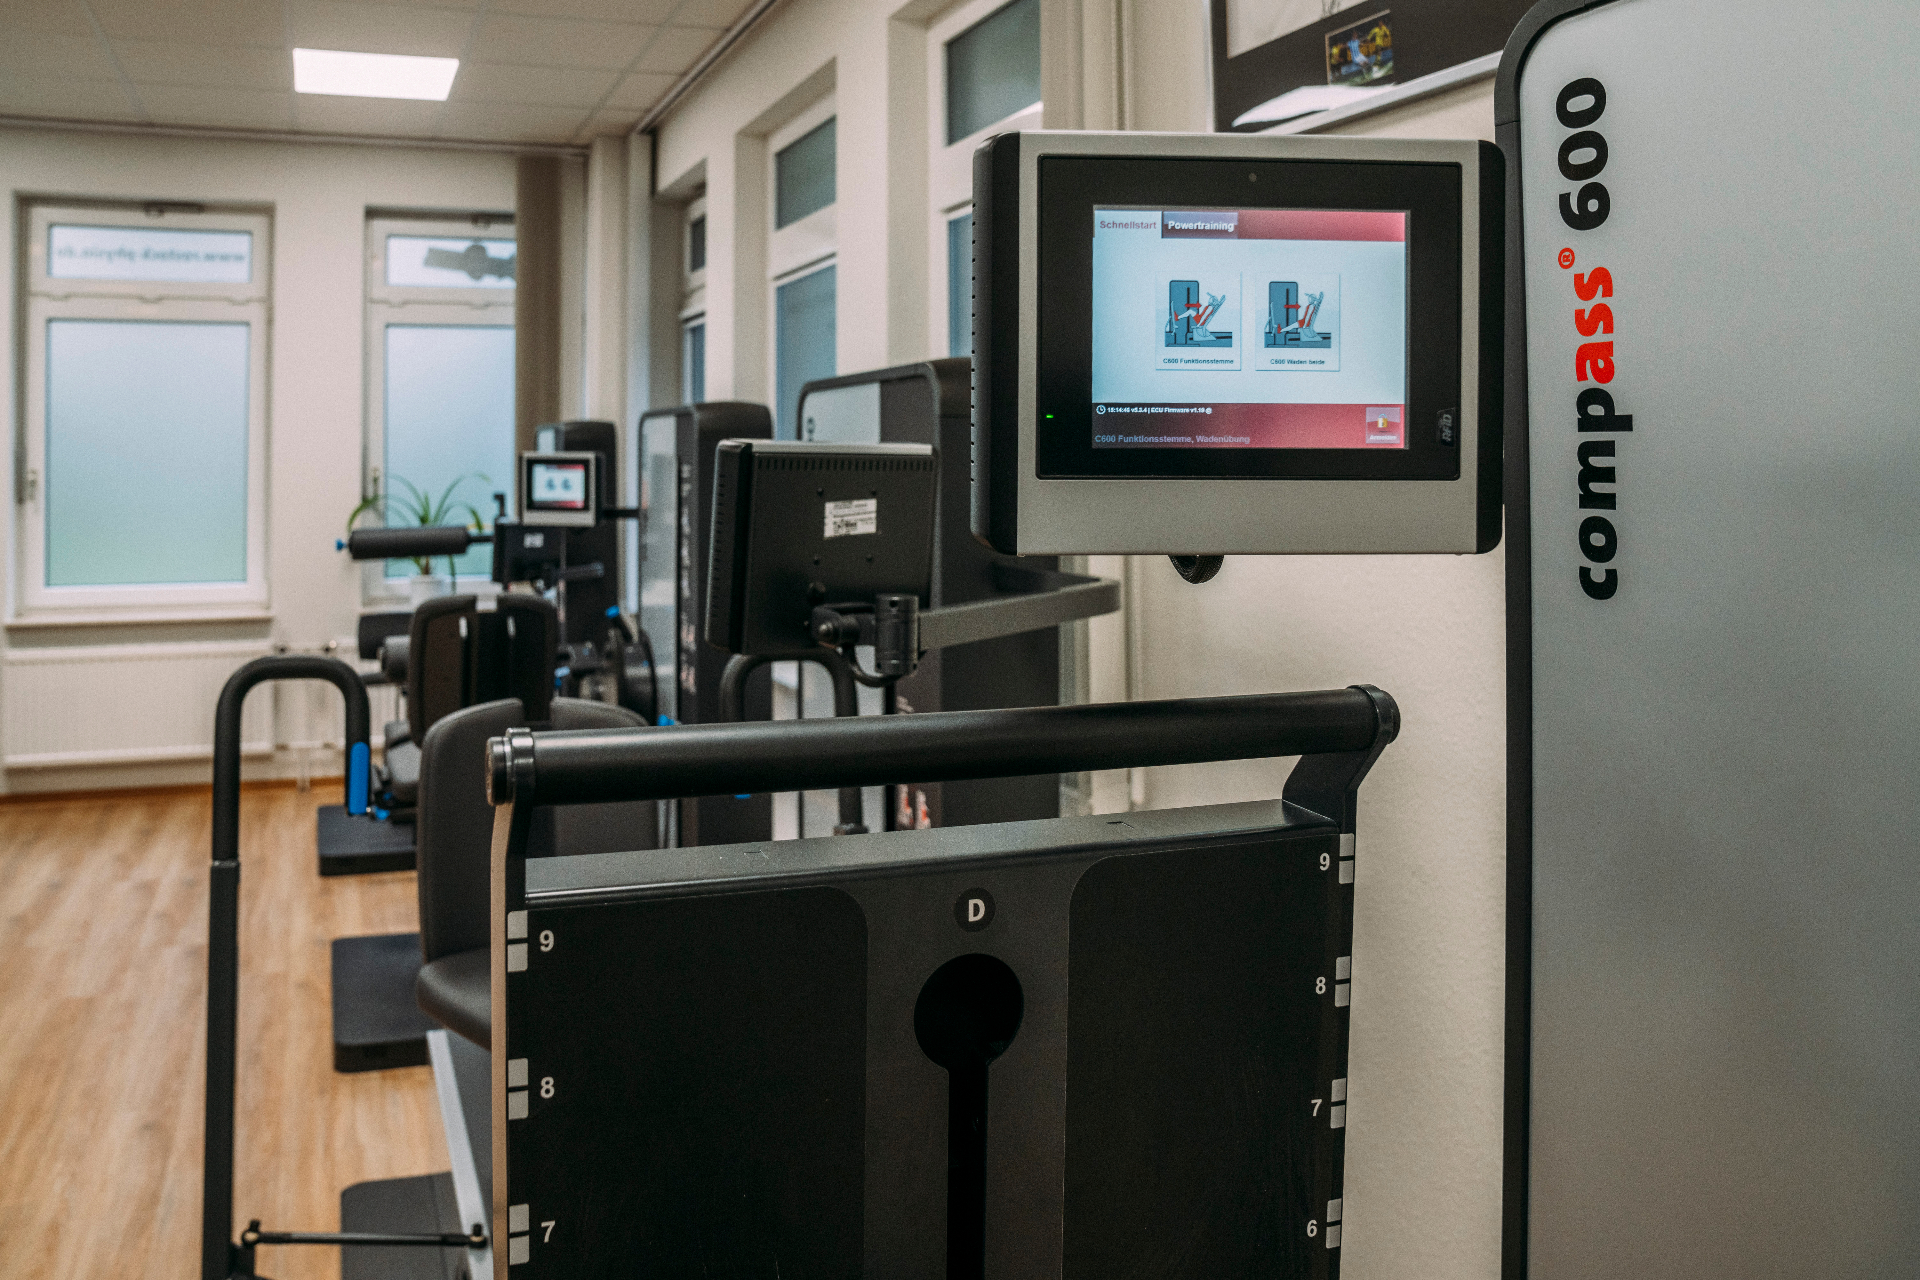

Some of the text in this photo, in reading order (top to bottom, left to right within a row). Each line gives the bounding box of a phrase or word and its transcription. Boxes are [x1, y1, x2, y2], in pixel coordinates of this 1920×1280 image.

[1555, 77, 1611, 231] 600
[1099, 220, 1157, 230] Schnellstart
[1167, 220, 1235, 233] Powertraining
[1162, 357, 1234, 366] C600 Funktionsstemme
[1270, 358, 1286, 366] C600
[1286, 358, 1308, 366] Waden
[1094, 434, 1116, 443] C600
[1195, 435, 1251, 445] Wadenübung
[1318, 852, 1331, 871] 9
[968, 898, 986, 922] D
[539, 929, 555, 953] 9
[1315, 976, 1327, 995] 8
[540, 1076, 555, 1099] 8
[1311, 1098, 1323, 1117] 7
[541, 1220, 556, 1244] 7
[1306, 1219, 1318, 1238] 6
